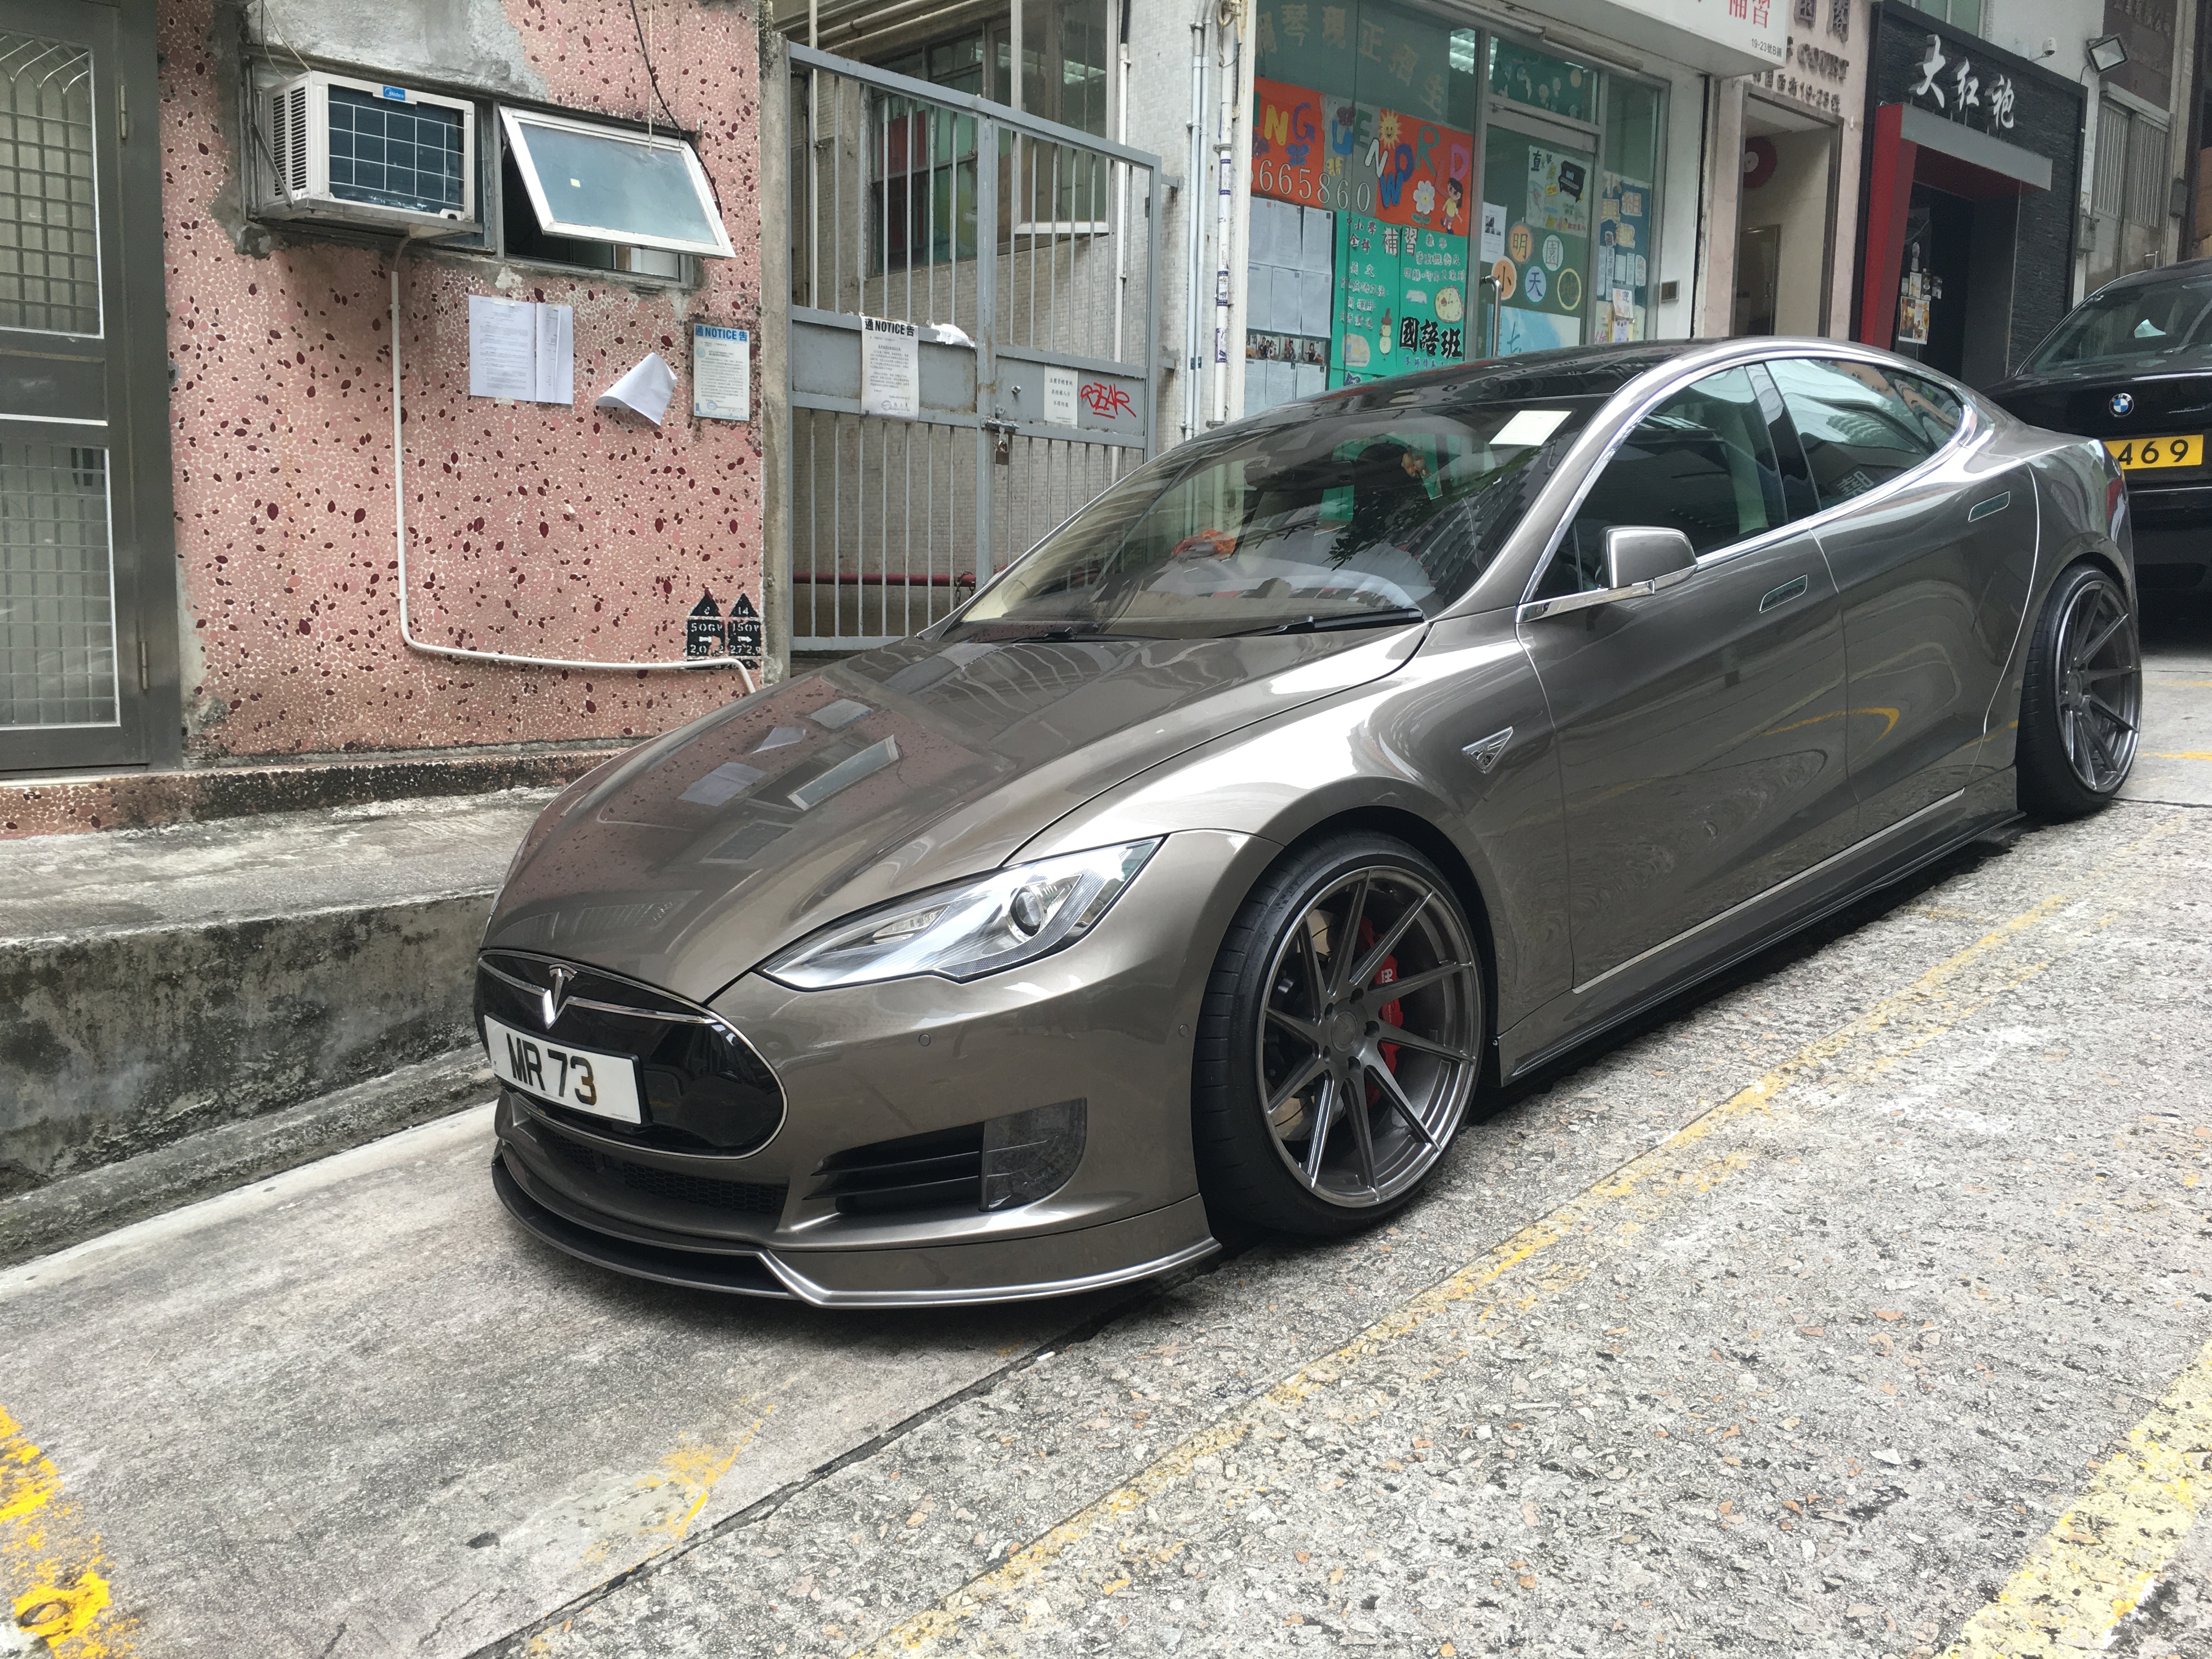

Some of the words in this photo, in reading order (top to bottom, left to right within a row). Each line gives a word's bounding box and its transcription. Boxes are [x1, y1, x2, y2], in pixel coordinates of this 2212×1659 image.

[1349, 233, 1370, 254] 全科
[1381, 226, 1419, 258] 補習
[1350, 261, 1375, 278] 英文
[695, 325, 704, 336] 通
[705, 327, 737, 340] NOTICE
[738, 331, 748, 342] 告
[864, 318, 874, 331] 通
[875, 320, 905, 335] NOTICE
[906, 325, 915, 337] 告
[1399, 317, 1463, 359] 國語班
[738, 606, 749, 615] 14
[506, 1032, 546, 1091] MR
[547, 1048, 597, 1106] 73
